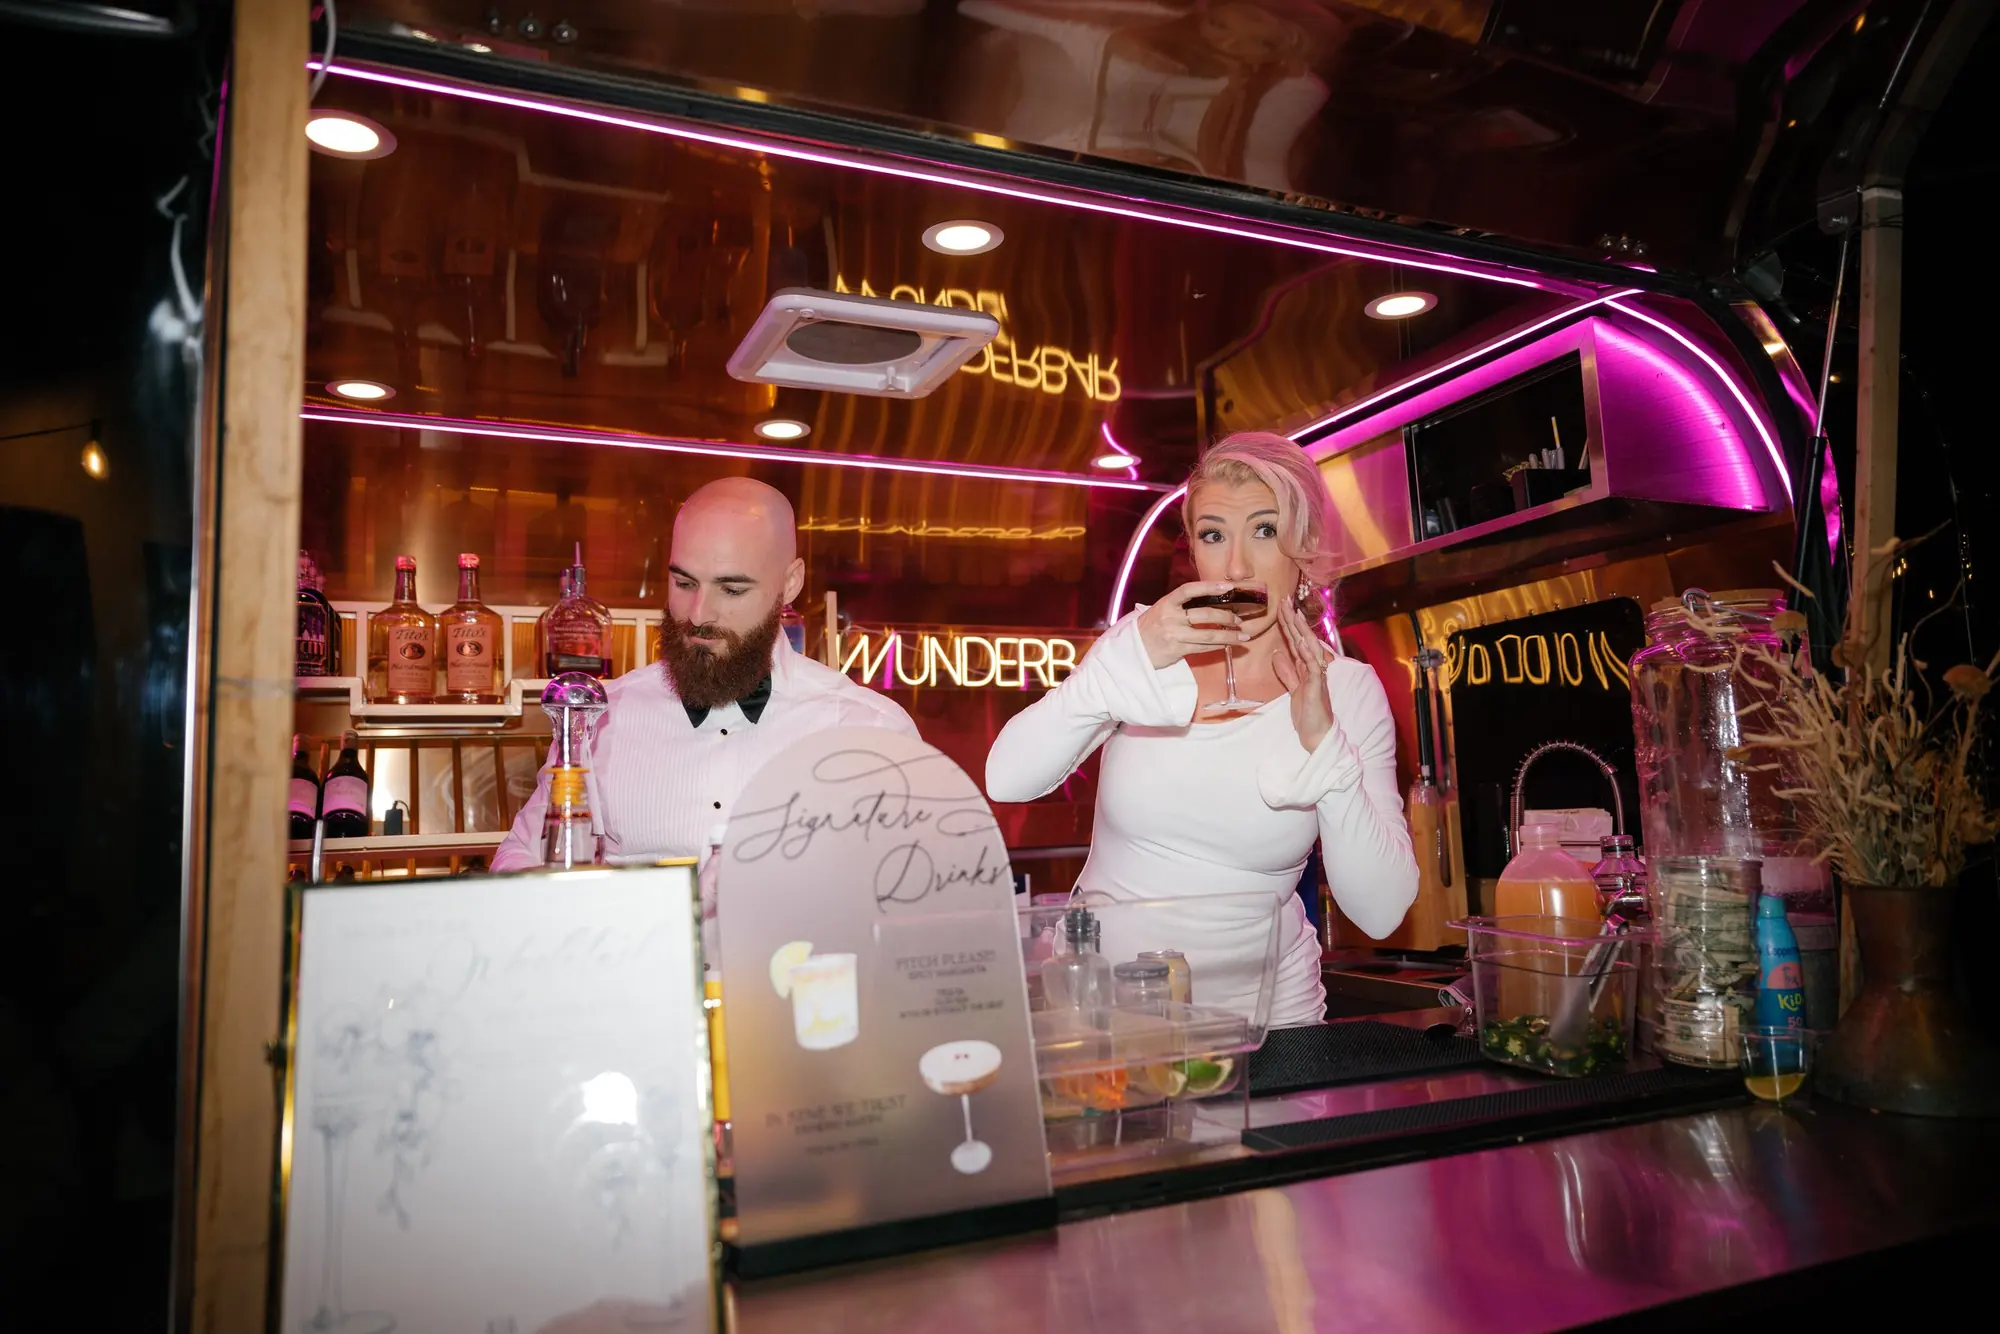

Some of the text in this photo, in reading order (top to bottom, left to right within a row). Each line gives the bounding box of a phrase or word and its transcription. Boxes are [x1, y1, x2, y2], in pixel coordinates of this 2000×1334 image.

[395, 628, 429, 641] Tito's
[452, 626, 487, 639] Tito's
[874, 840, 1010, 914] Drinks
